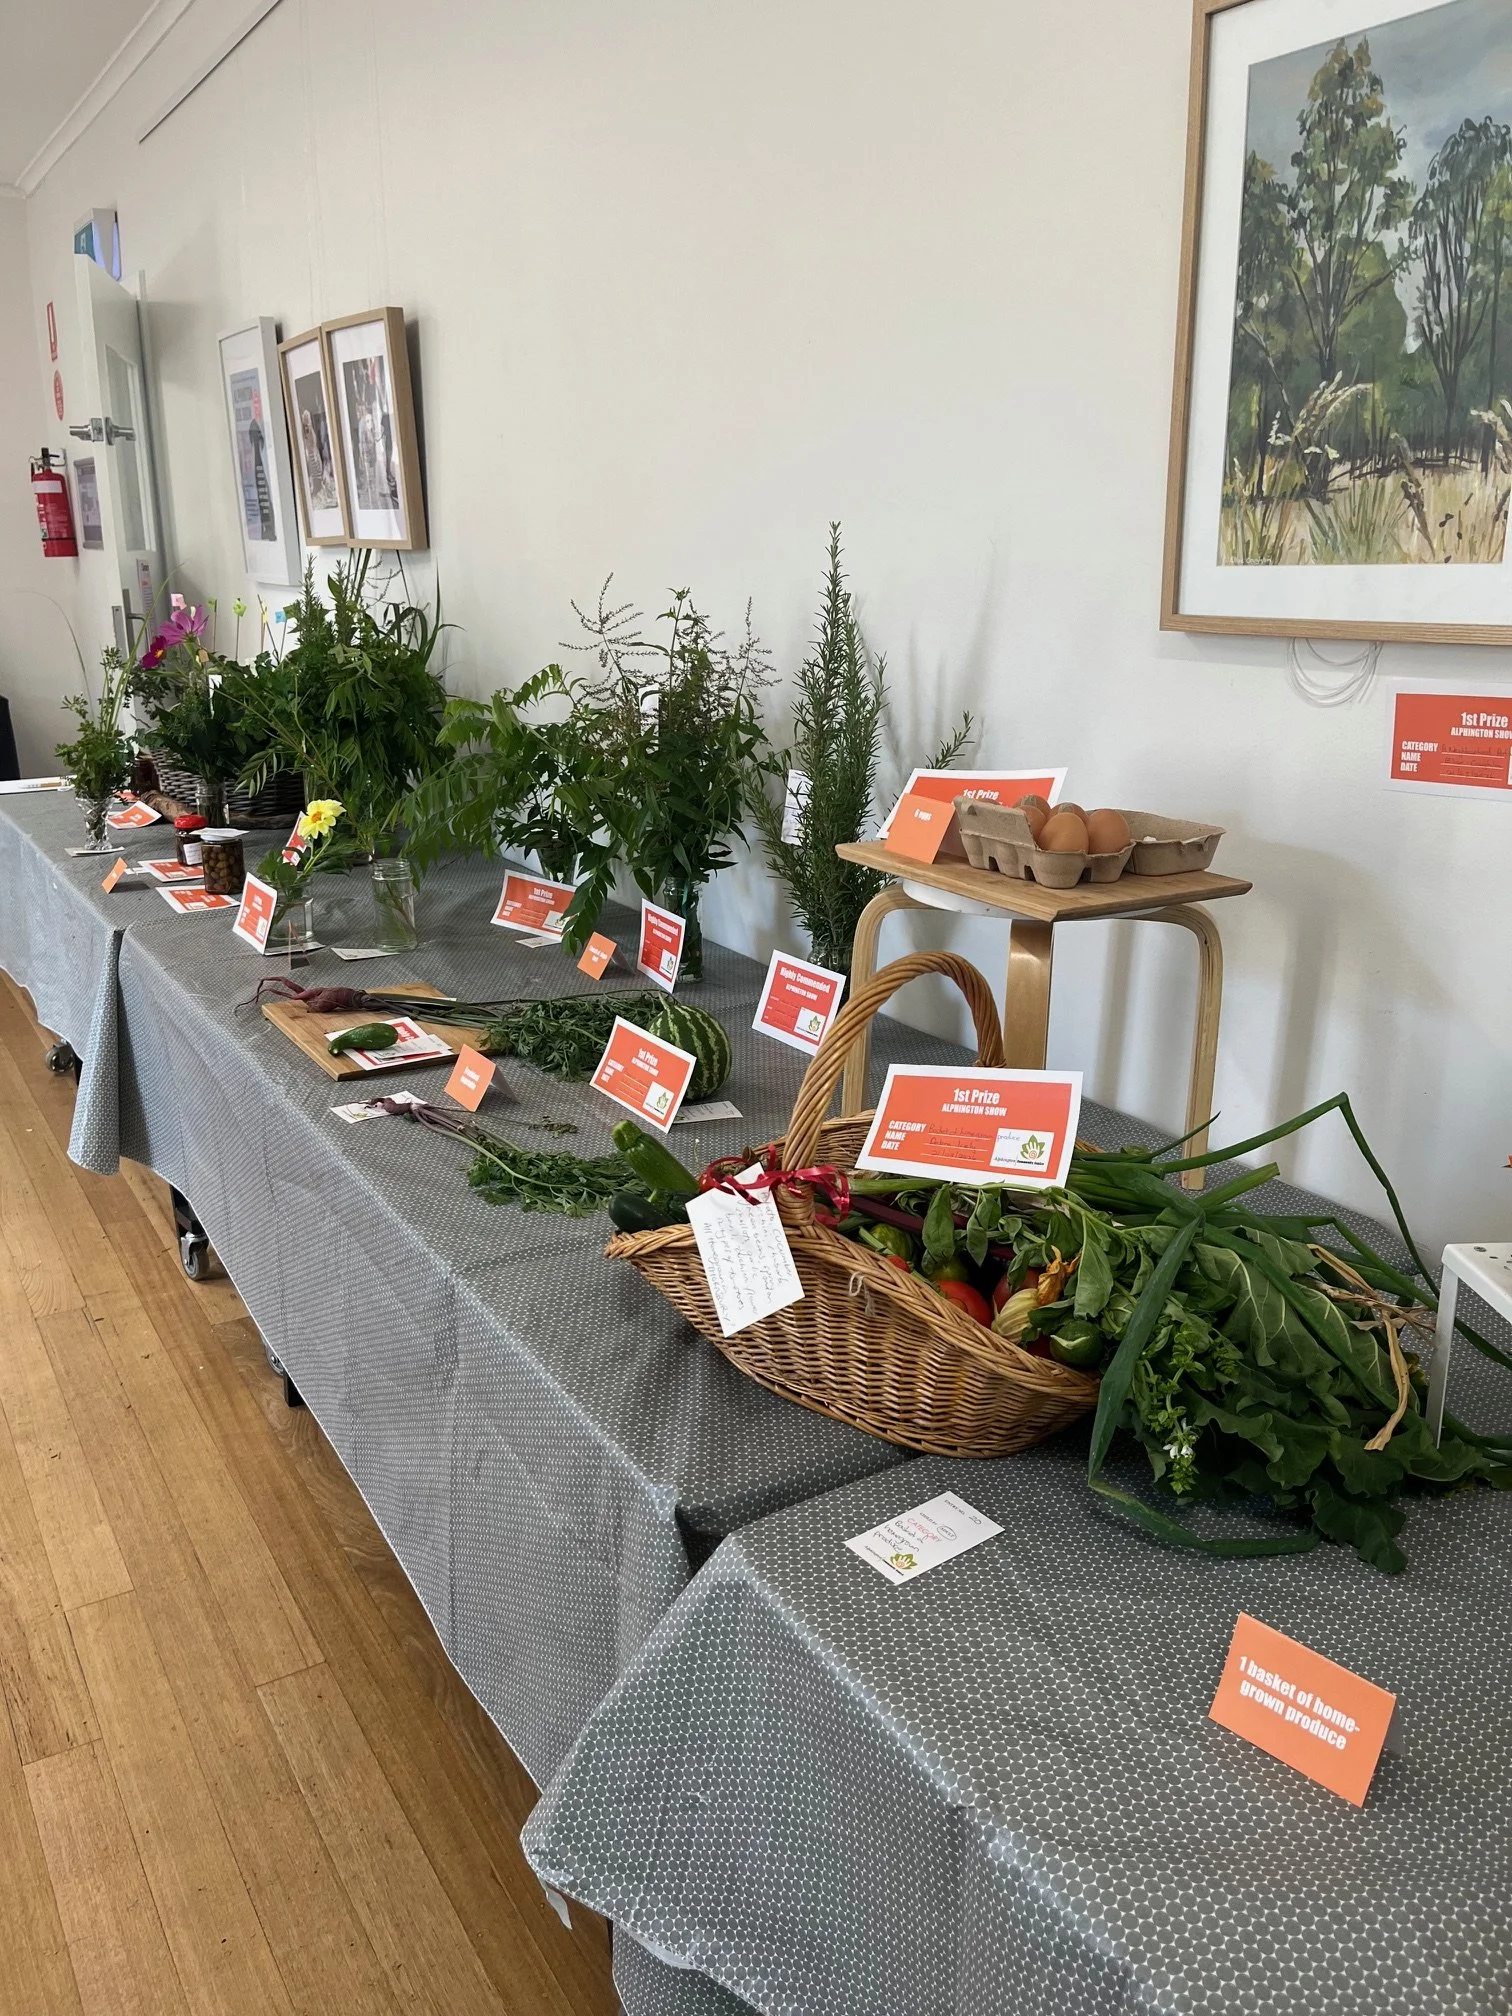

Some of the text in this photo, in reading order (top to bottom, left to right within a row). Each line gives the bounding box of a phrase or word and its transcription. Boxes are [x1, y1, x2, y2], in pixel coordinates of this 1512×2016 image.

[1461, 712, 1508, 728] 1st Prize
[1450, 727, 1494, 738] ALPHINGTON
[1401, 741, 1438, 752] CATEGORY
[1401, 751, 1422, 762] NAME
[1400, 762, 1418, 772] DATE
[963, 789, 1000, 801] 1st Prize
[780, 967, 831, 993] Highly Commended
[953, 1088, 1000, 1105] 1st Prize
[942, 1103, 1007, 1117] ALPHINGTON SHOW
[888, 1120, 927, 1133] CATEGORY
[885, 1130, 906, 1142] NAME
[880, 1140, 899, 1151] DATE
[1239, 1655, 1360, 1733] 1 basket of home-
[1240, 1679, 1347, 1750] grown produce
